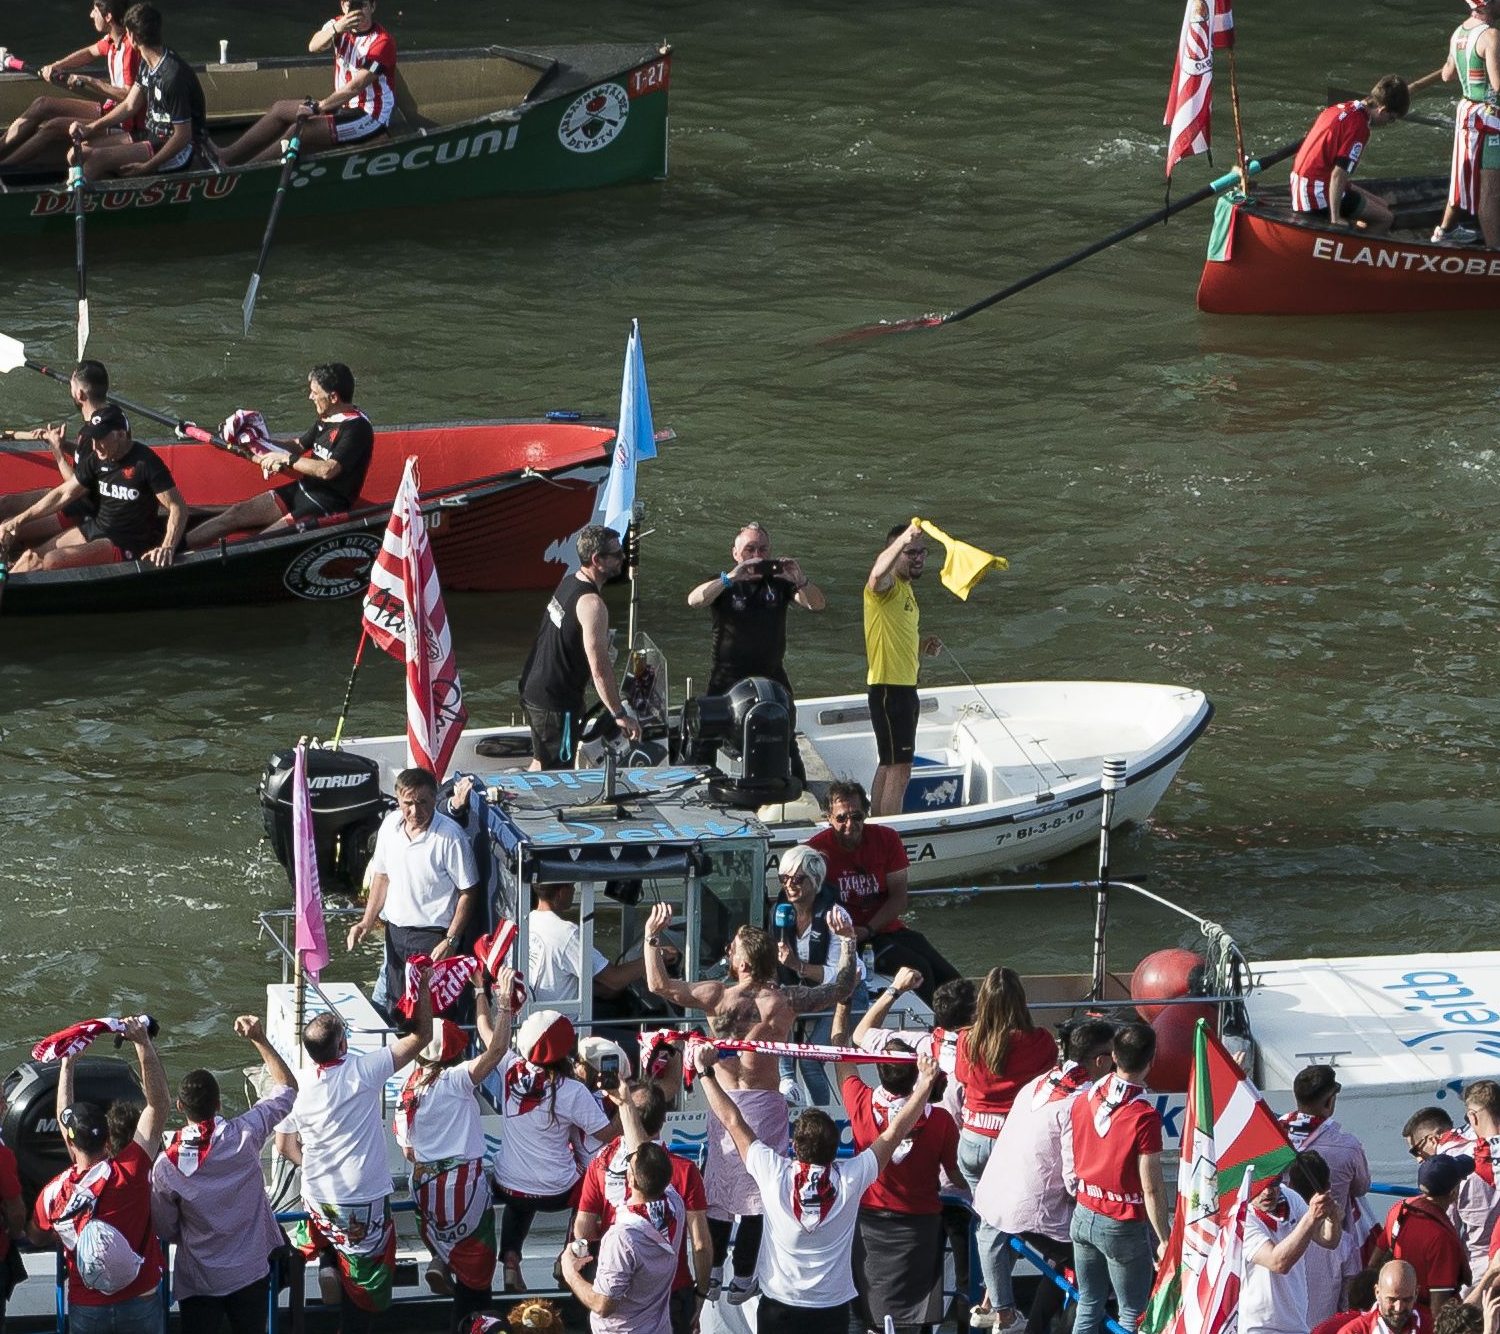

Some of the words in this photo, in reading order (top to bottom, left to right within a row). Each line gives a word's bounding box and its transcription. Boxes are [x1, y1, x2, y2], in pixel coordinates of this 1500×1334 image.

[634, 62, 665, 91] T-27
[341, 124, 520, 182] tecuni
[30, 174, 241, 216] DEUSTU
[306, 772, 372, 789] VINRUDE
